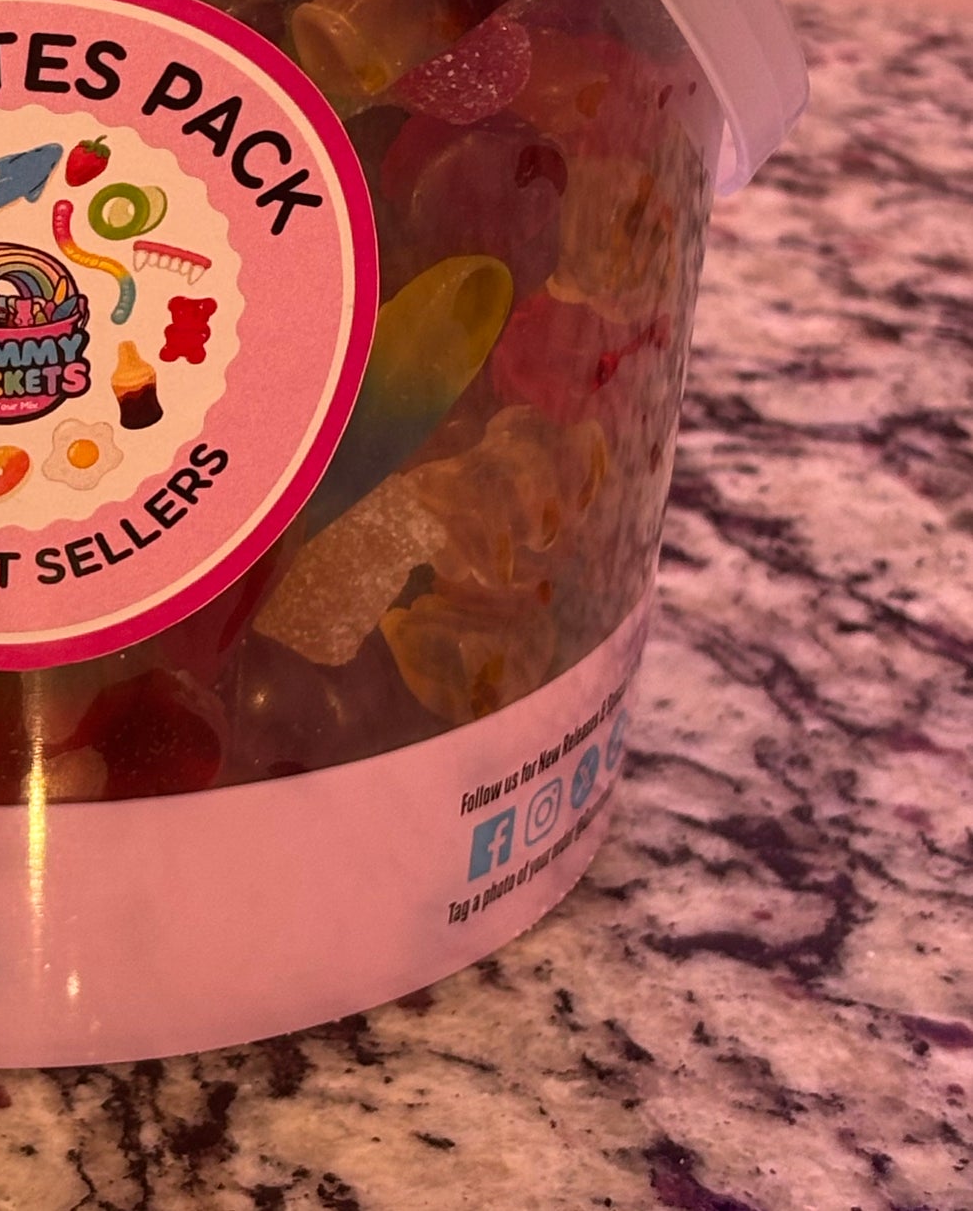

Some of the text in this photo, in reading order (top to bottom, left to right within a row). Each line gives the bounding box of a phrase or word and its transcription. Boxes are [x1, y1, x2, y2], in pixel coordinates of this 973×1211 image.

[141, 60, 323, 236] PACK
[20, 400, 40, 412] Mix
[36, 442, 230, 585] SELLERS
[460, 780, 502, 817] Follow
[503, 769, 519, 793] us
[520, 759, 537, 786] for
[538, 743, 561, 775] New
[447, 898, 470, 925] Tag
[471, 893, 481, 913] a
[481, 872, 516, 912] photo
[516, 860, 529, 887] of
